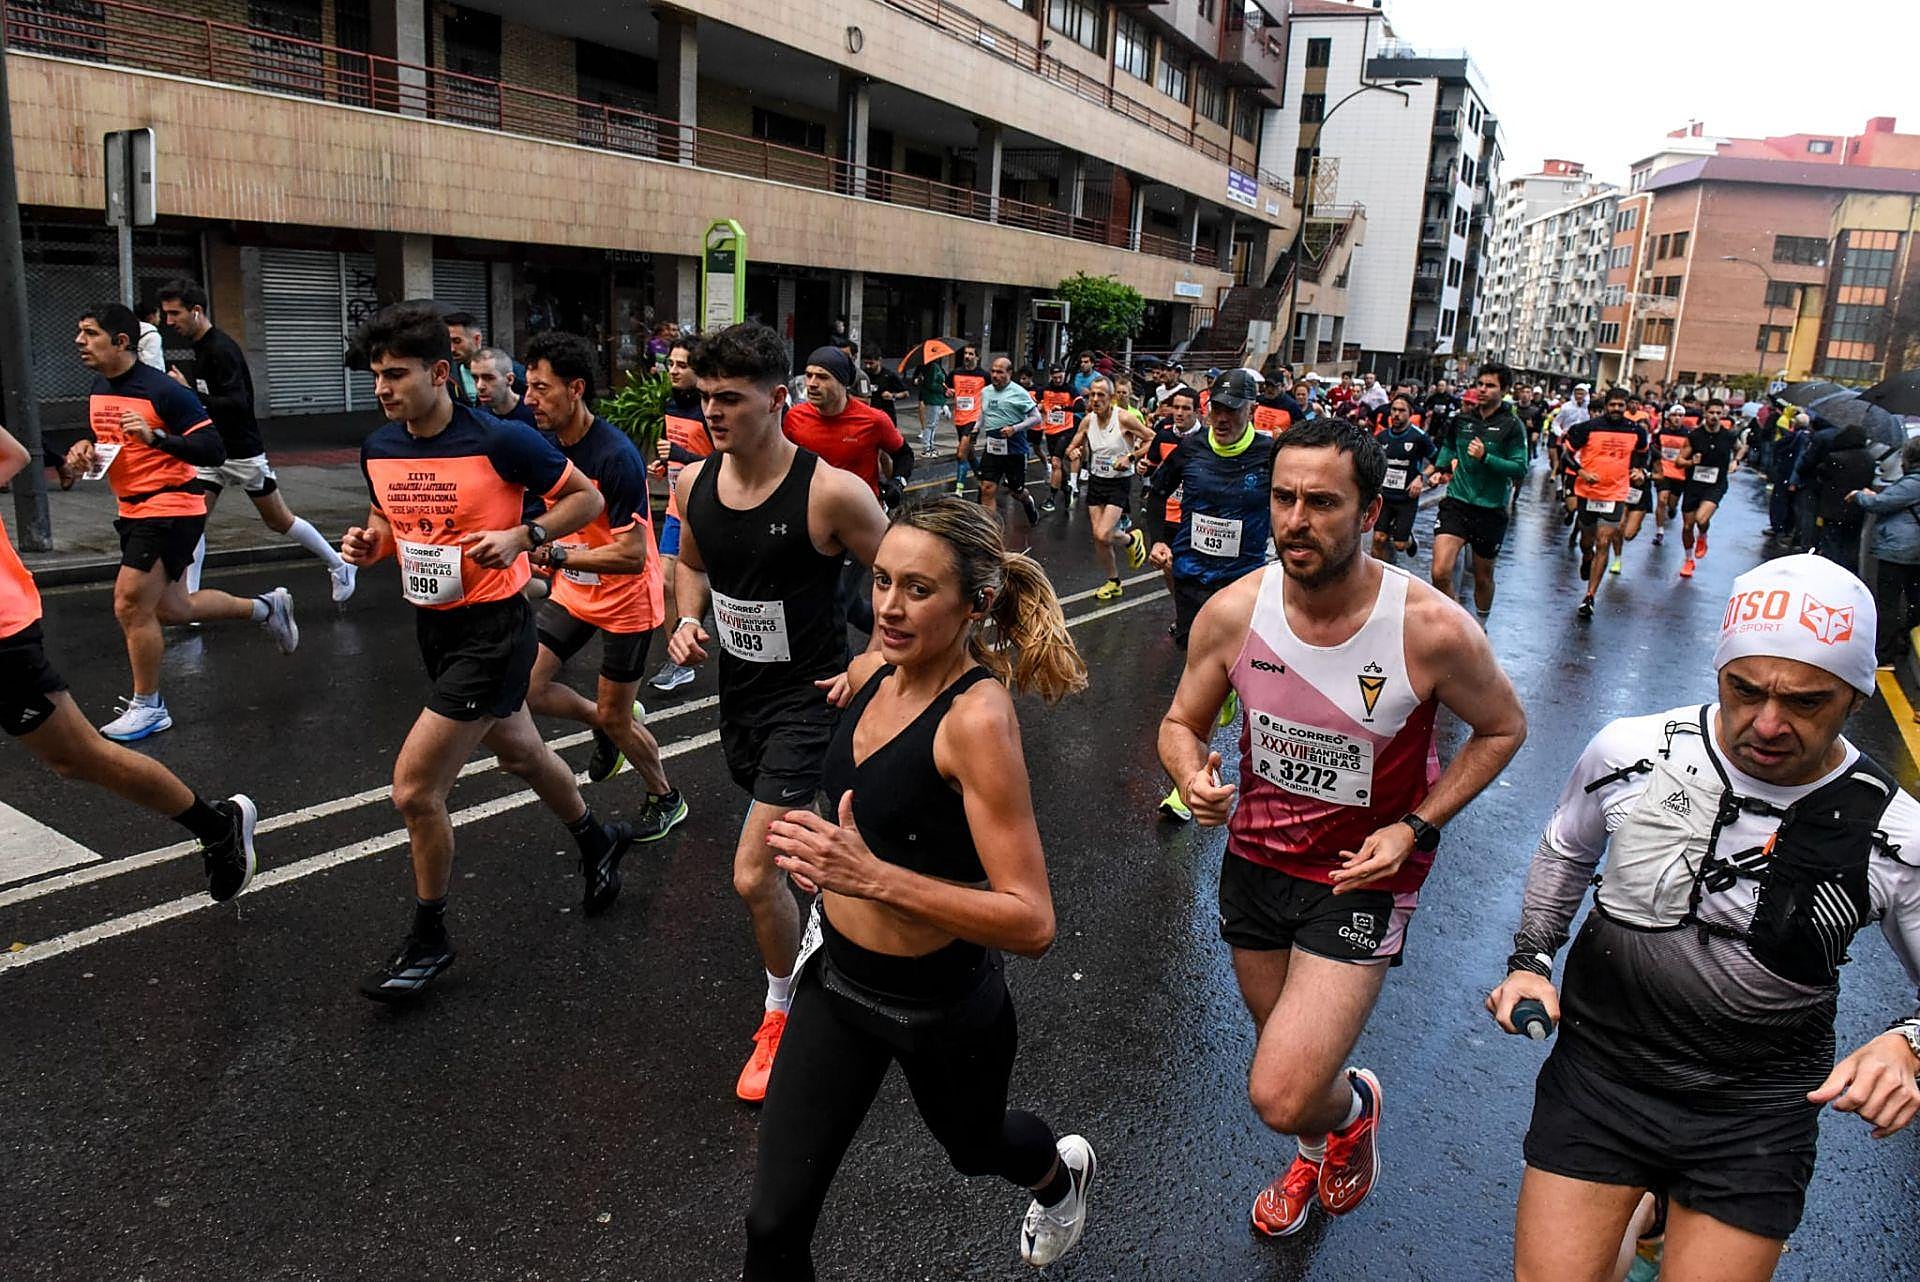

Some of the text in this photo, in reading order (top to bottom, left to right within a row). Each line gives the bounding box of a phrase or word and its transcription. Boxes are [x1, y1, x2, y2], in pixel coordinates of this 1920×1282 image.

[1204, 537, 1223, 549] 433
[420, 568, 452, 576] BILBAO
[409, 576, 439, 594] 1998
[728, 603, 761, 614] CORREO
[1722, 589, 1791, 632] OTSO
[741, 624, 777, 632] BILBAO
[1739, 623, 1784, 634] SPORT
[730, 630, 763, 652] 1893
[1272, 722, 1287, 734] EL
[1288, 727, 1344, 745] CORREO
[1260, 732, 1308, 760] XXXVII
[1310, 747, 1361, 763] SANTURCE
[1309, 753, 1361, 770] BILBAO
[1270, 772, 1321, 795] kutxabank
[1279, 758, 1338, 792] 3272
[1338, 926, 1377, 949] Getxo
